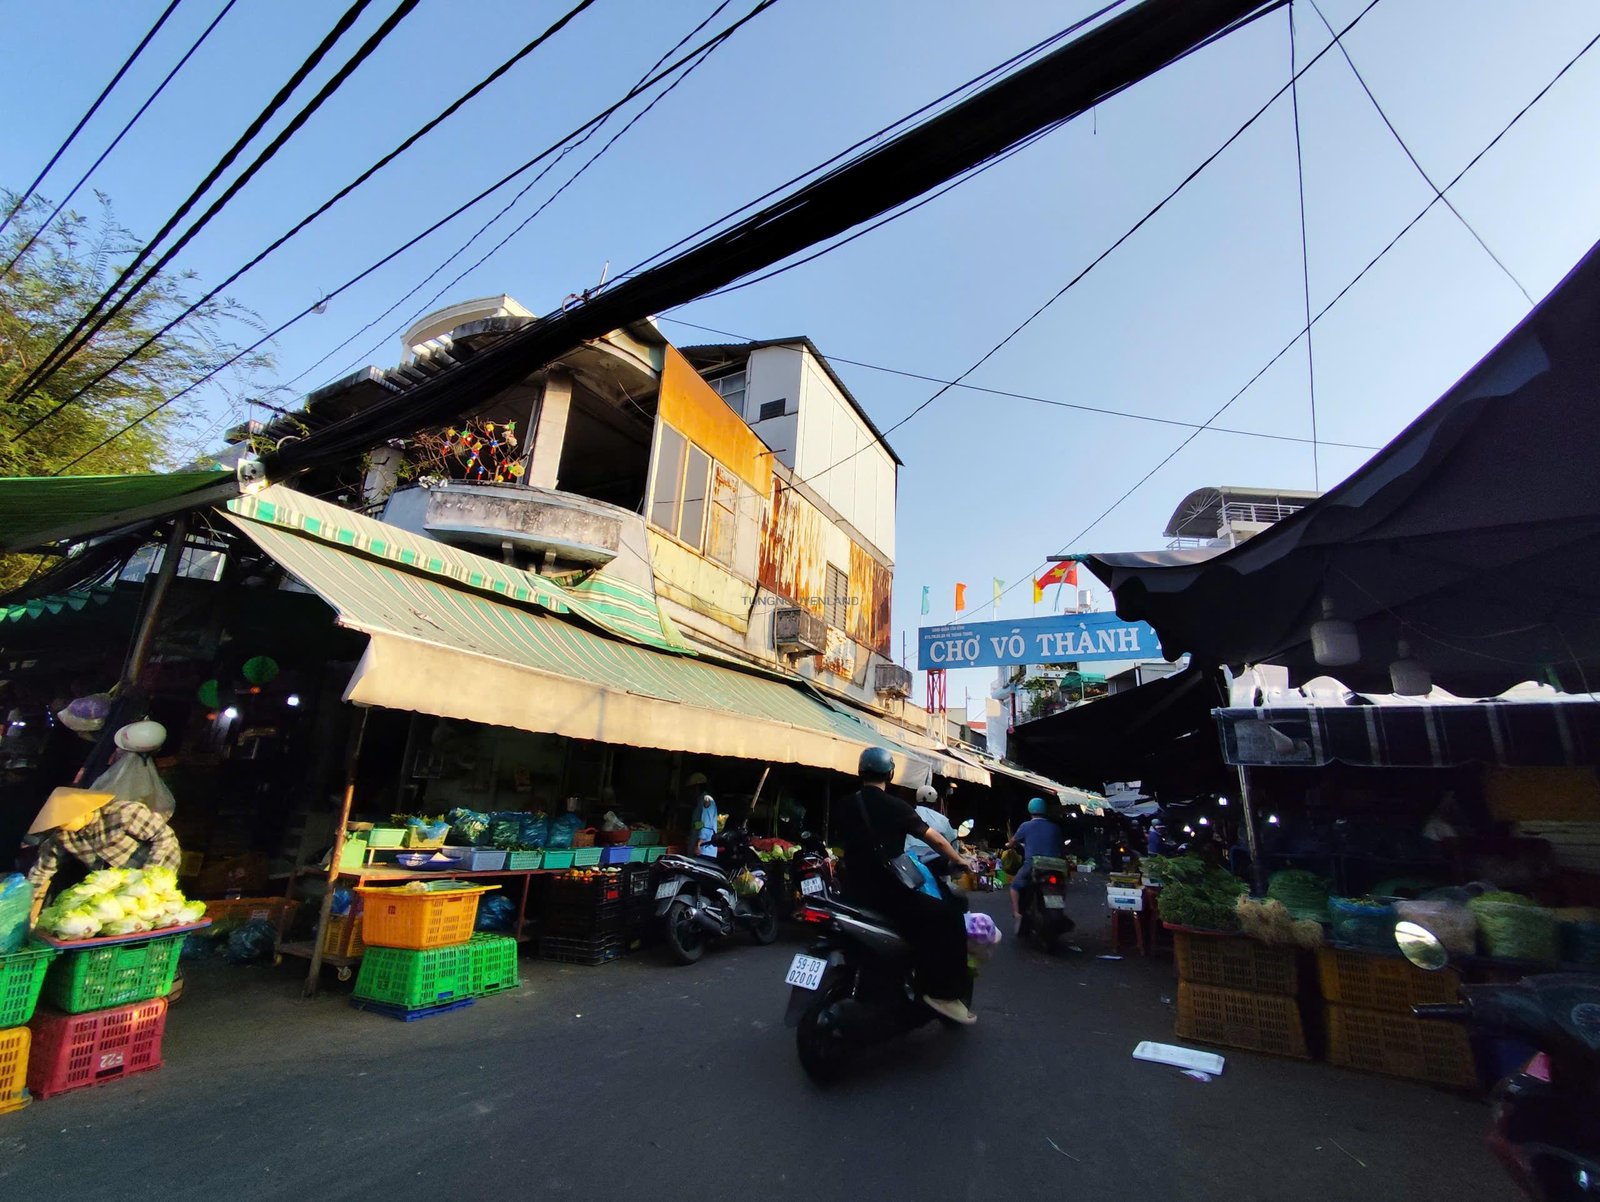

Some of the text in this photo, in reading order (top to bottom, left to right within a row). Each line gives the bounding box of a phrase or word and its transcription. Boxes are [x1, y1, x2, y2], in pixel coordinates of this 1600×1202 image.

[930, 634, 980, 666] CHỢ
[990, 628, 1025, 659] VÕ
[1036, 622, 1140, 656] THÀNH
[796, 957, 821, 973] 59-D3
